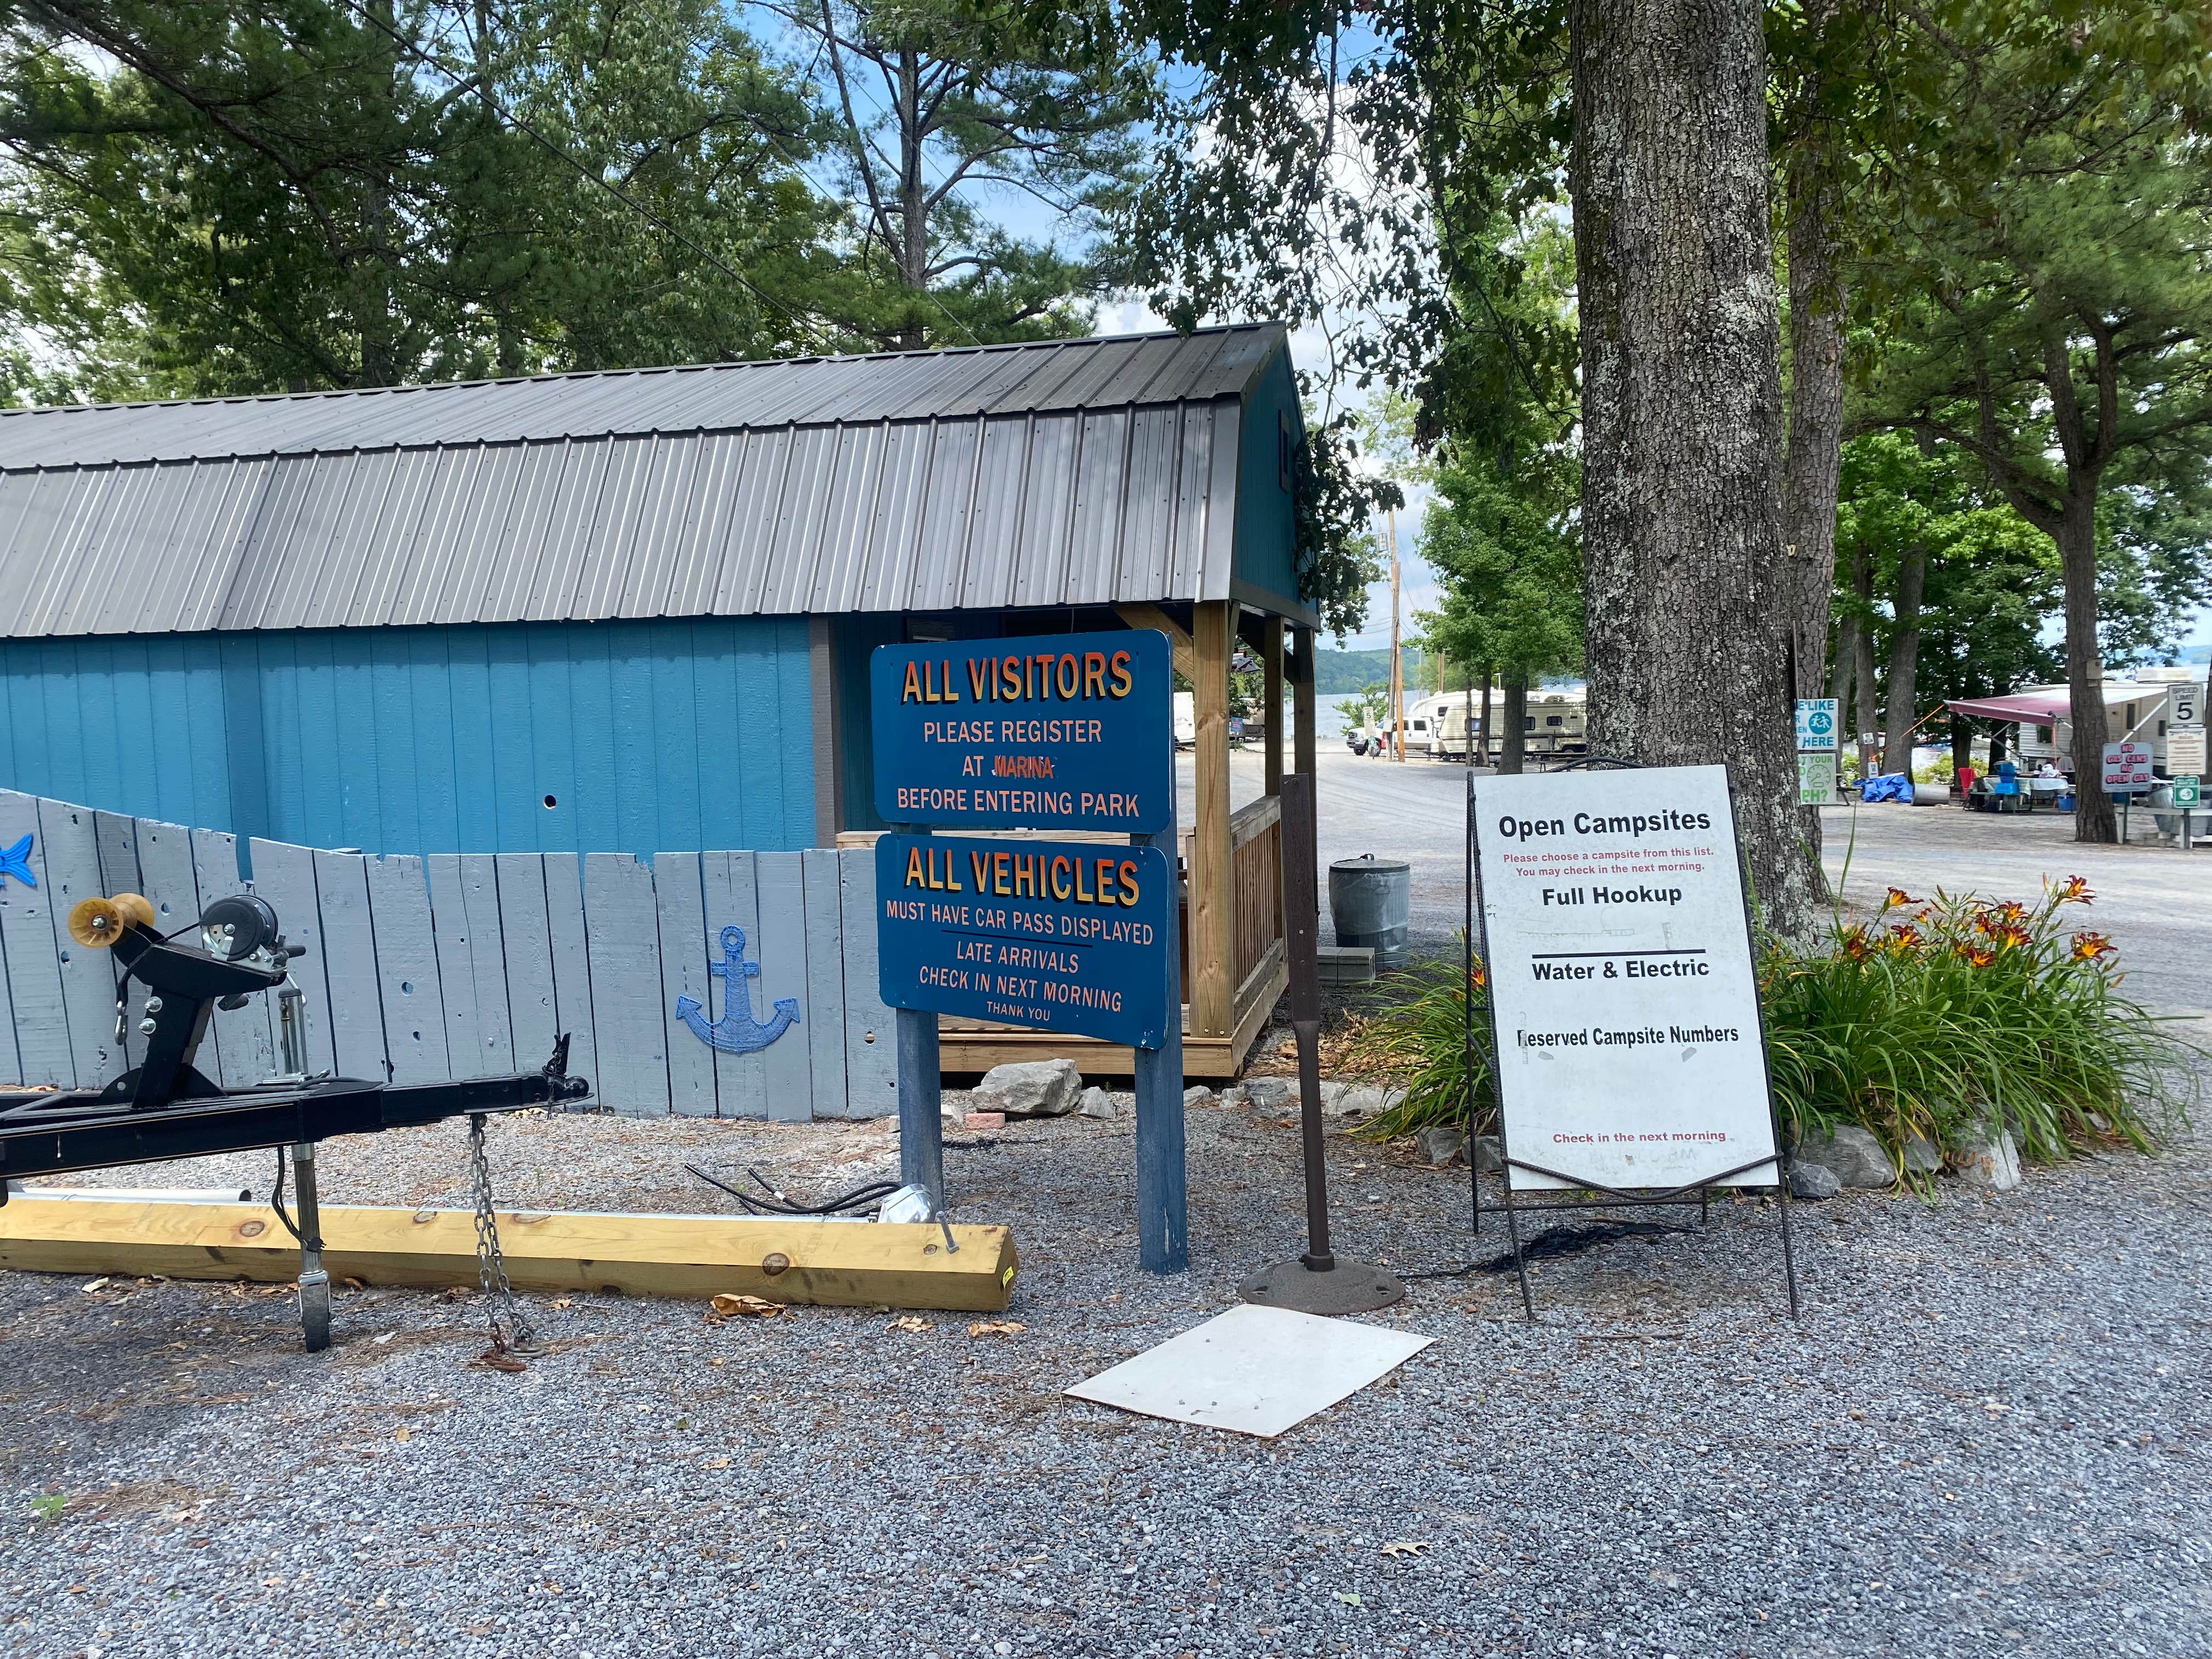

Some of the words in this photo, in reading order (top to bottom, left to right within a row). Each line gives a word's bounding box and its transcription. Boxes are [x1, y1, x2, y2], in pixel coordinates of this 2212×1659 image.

[901, 659, 959, 705] ALL
[969, 650, 1132, 703] VISITORS
[1808, 700, 1834, 710] LIKE
[2177, 702, 2193, 720] 5
[924, 721, 994, 743] PLEASE
[1002, 720, 1102, 742] REGISTER
[1803, 737, 1833, 746] HERE
[2121, 743, 2135, 753] NO
[962, 755, 984, 777] AT
[994, 755, 1053, 778] MARINA
[2106, 775, 2129, 784] OPEN
[898, 788, 967, 811] BEFORE
[974, 790, 1073, 815] ENTERING
[1081, 793, 1139, 817] PARK
[1802, 789, 1828, 802] PH?
[1499, 816, 1565, 842] Open
[1574, 809, 1711, 837] Campsites
[1503, 854, 1538, 863] Please
[1542, 853, 1579, 861] choose
[1592, 849, 1640, 861] campsite
[1643, 849, 1668, 858] from
[1671, 848, 1691, 856] this
[1694, 847, 1714, 856] list.
[905, 847, 962, 893] ALL
[970, 851, 1139, 907] VEHICLES
[1516, 867, 1535, 876] You
[1539, 868, 1560, 877] may
[1564, 865, 1595, 874] check
[1598, 865, 1608, 873] in
[1611, 864, 1628, 873] the
[1632, 864, 1655, 872] next
[1658, 861, 1705, 873] morning.
[1542, 887, 1584, 906] Full
[1593, 885, 1682, 906] Hookup
[887, 900, 926, 921] MUST
[932, 904, 969, 926] HAVE
[975, 908, 1006, 929] CAR
[1013, 911, 1054, 934] PASS
[1062, 916, 1153, 945] DISPLAYED
[957, 941, 992, 963] LATE
[998, 945, 1079, 974] ARRIVALS
[1532, 961, 1595, 980] Water
[1604, 961, 1618, 978] &
[1627, 958, 1710, 978] Electric
[919, 966, 968, 990] CHECK
[975, 973, 989, 992] IN
[997, 975, 1037, 999] NEXT
[1043, 981, 1121, 1013] MORNING
[987, 1001, 1024, 1018] THANK
[1028, 1008, 1051, 1022] YOU
[1593, 1027, 1665, 1049] Campsite
[1670, 1025, 1739, 1043] Numbers
[1553, 1133, 1594, 1143] Check
[1598, 1133, 1610, 1142] in
[1613, 1132, 1635, 1142] the
[1639, 1132, 1668, 1142] next
[1672, 1131, 1726, 1142] morning
